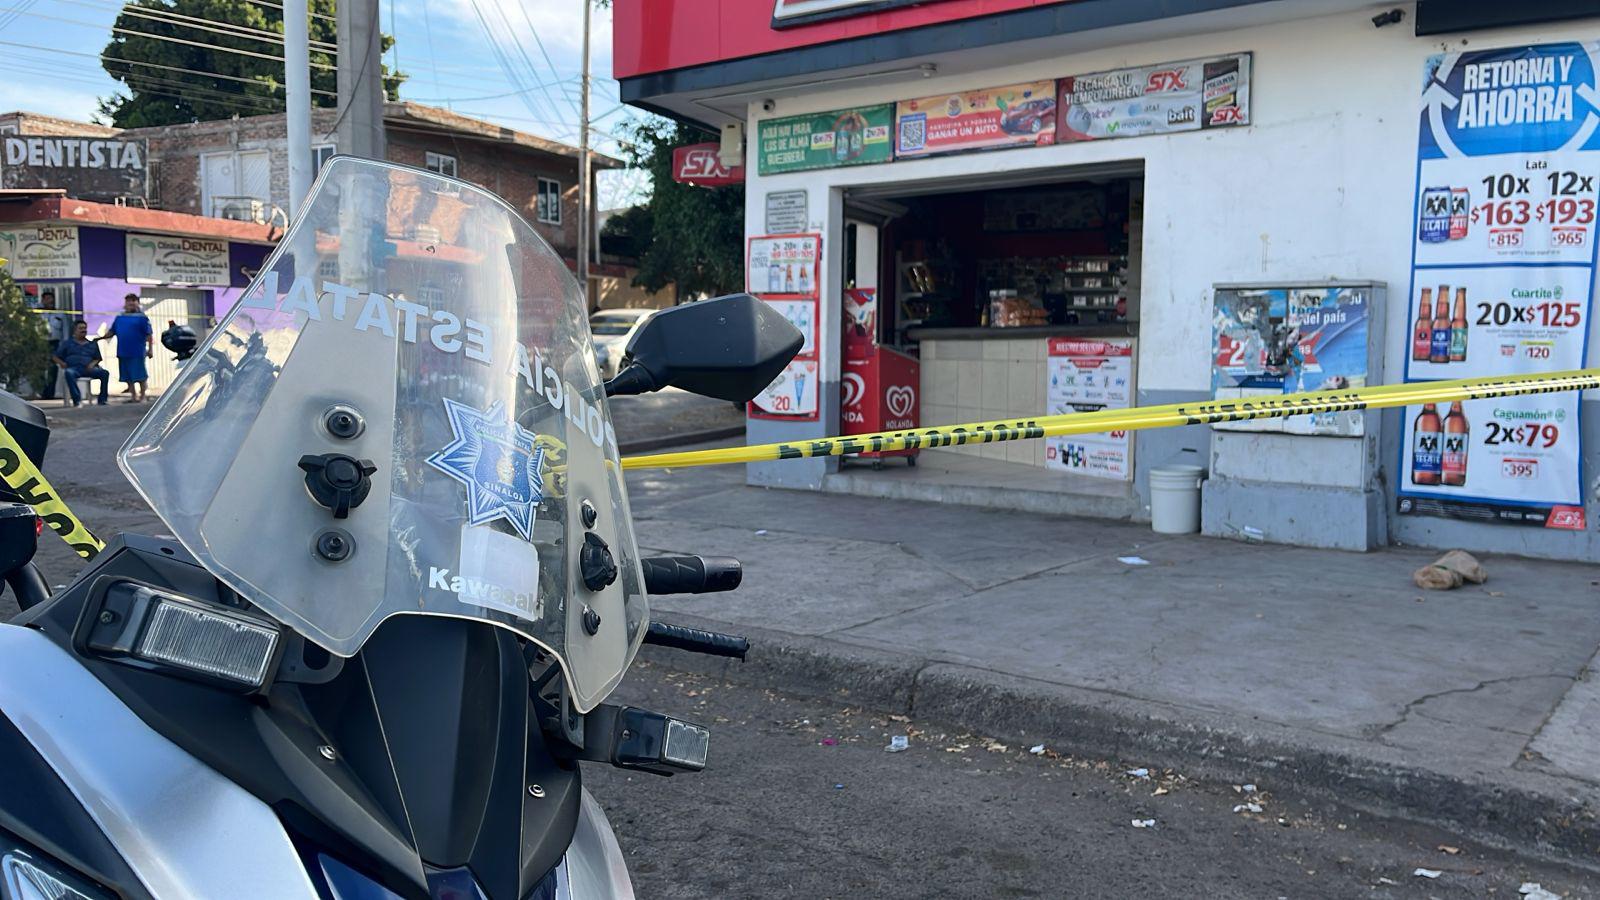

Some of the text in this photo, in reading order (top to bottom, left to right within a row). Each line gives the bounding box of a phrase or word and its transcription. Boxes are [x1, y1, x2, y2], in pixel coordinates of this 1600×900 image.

[1145, 68, 1188, 94] SIX
[1464, 55, 1574, 91] RETORNA Y
[1168, 107, 1195, 125] bait
[1211, 105, 1243, 124] SIX
[1457, 84, 1573, 129] AHORRA
[927, 124, 998, 141] GANAR UN AUTO
[5, 138, 142, 169] DENTISTA
[1526, 160, 1548, 170] Lata
[1482, 174, 1530, 198] 10x
[1547, 171, 1593, 196] 12x
[1471, 199, 1530, 226] $163
[1535, 199, 1595, 224] $193
[37, 228, 75, 241] DENTAL
[182, 240, 226, 252] DENTAL
[1511, 287, 1552, 300] Cuartito
[1323, 309, 1346, 326] país
[886, 420, 913, 430] HOLANDA
[484, 481, 524, 503] SINALOA
